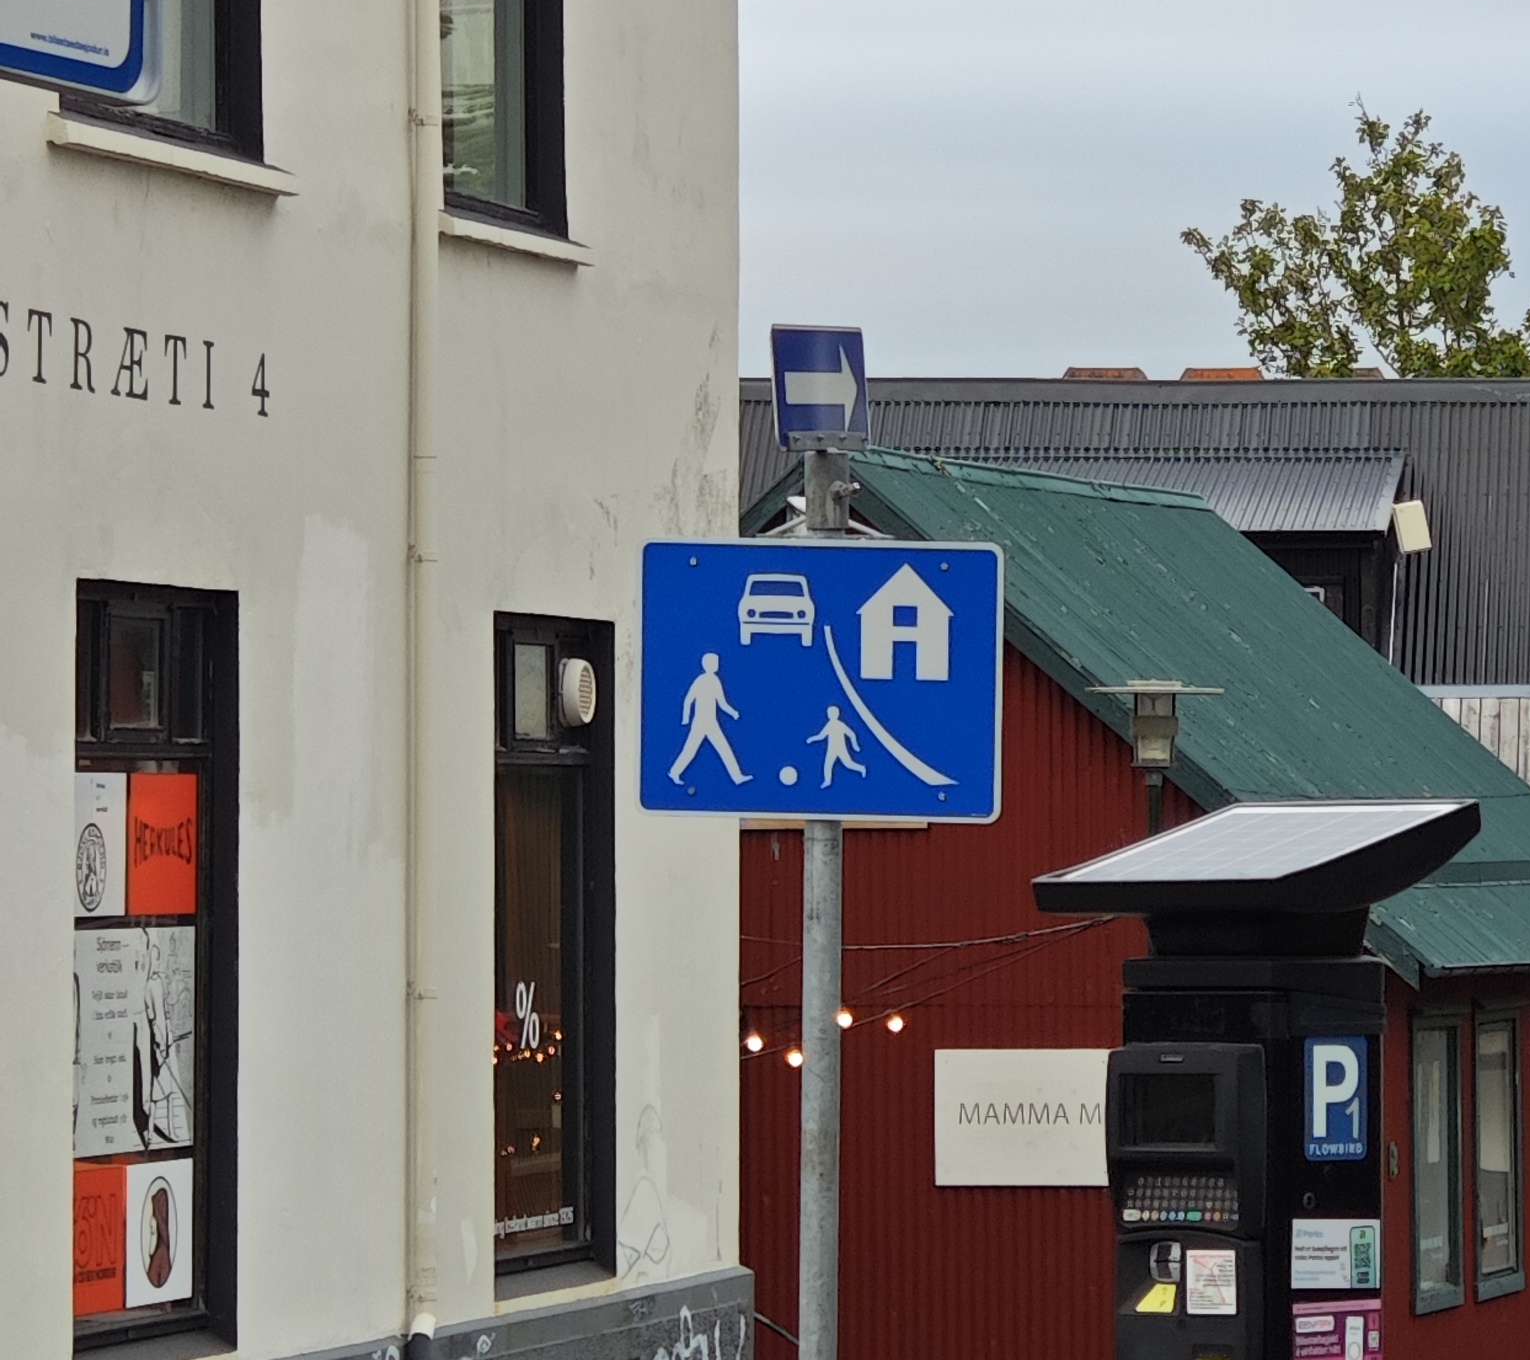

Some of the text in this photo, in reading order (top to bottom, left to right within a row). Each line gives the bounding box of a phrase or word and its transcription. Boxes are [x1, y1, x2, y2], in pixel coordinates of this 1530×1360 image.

[251, 352, 271, 418] 4
[959, 1102, 1101, 1125] MAMMA M
